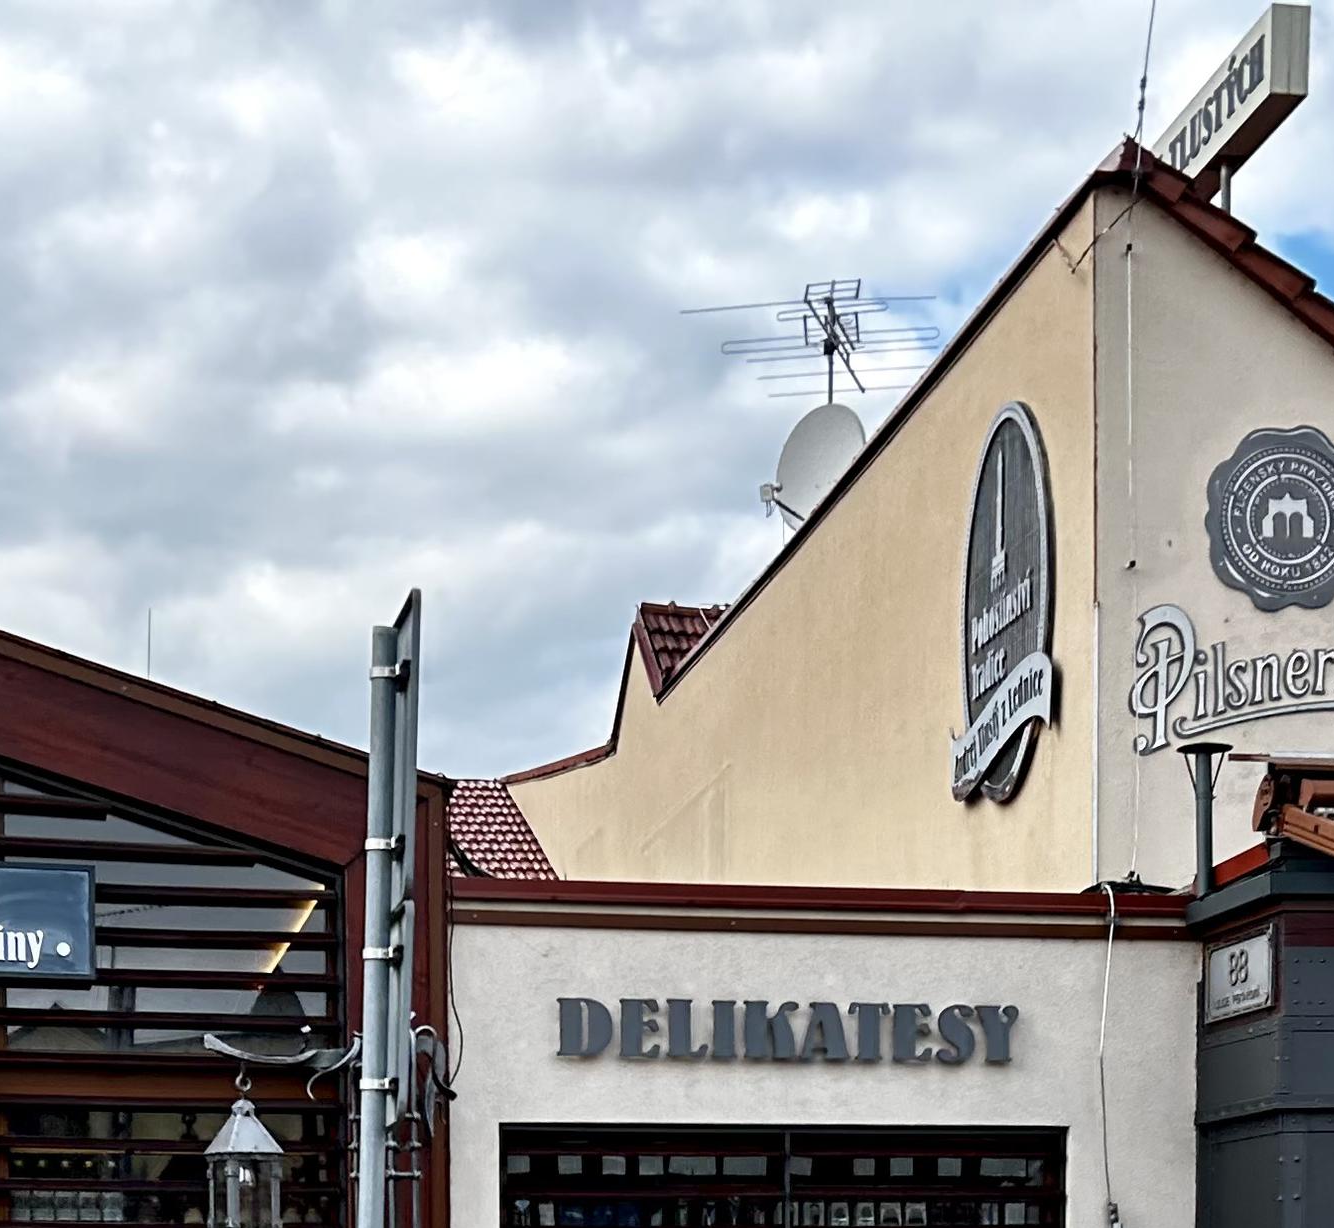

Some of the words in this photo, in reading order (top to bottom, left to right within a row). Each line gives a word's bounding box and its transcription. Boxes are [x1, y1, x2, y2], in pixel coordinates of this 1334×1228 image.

[1242, 543, 1259, 563] OD
[1260, 559, 1301, 577] ROKU
[971, 568, 1033, 655] Pohostinství
[971, 646, 1007, 701] Tradice
[1007, 667, 1044, 718] Lednice
[555, 997, 1020, 1065] DELIKATESY
